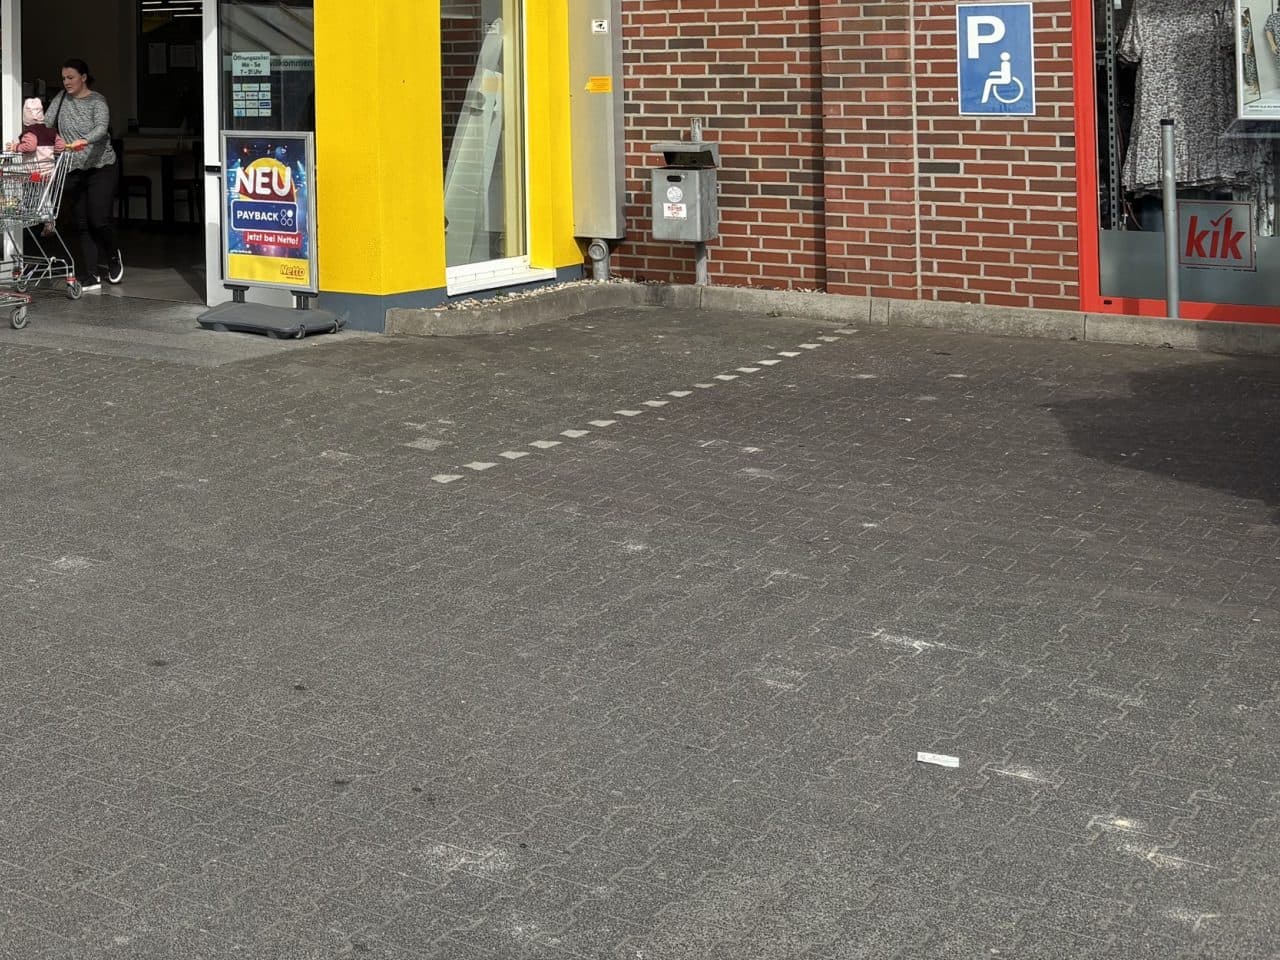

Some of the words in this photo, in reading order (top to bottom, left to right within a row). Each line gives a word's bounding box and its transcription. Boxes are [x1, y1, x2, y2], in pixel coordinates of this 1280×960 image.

[966, 15, 1006, 59] P
[234, 166, 291, 197] NEU
[236, 210, 279, 221] PAYBACK
[263, 234, 276, 243] bei
[277, 235, 299, 245] Netto!
[280, 264, 305, 277] Netto
